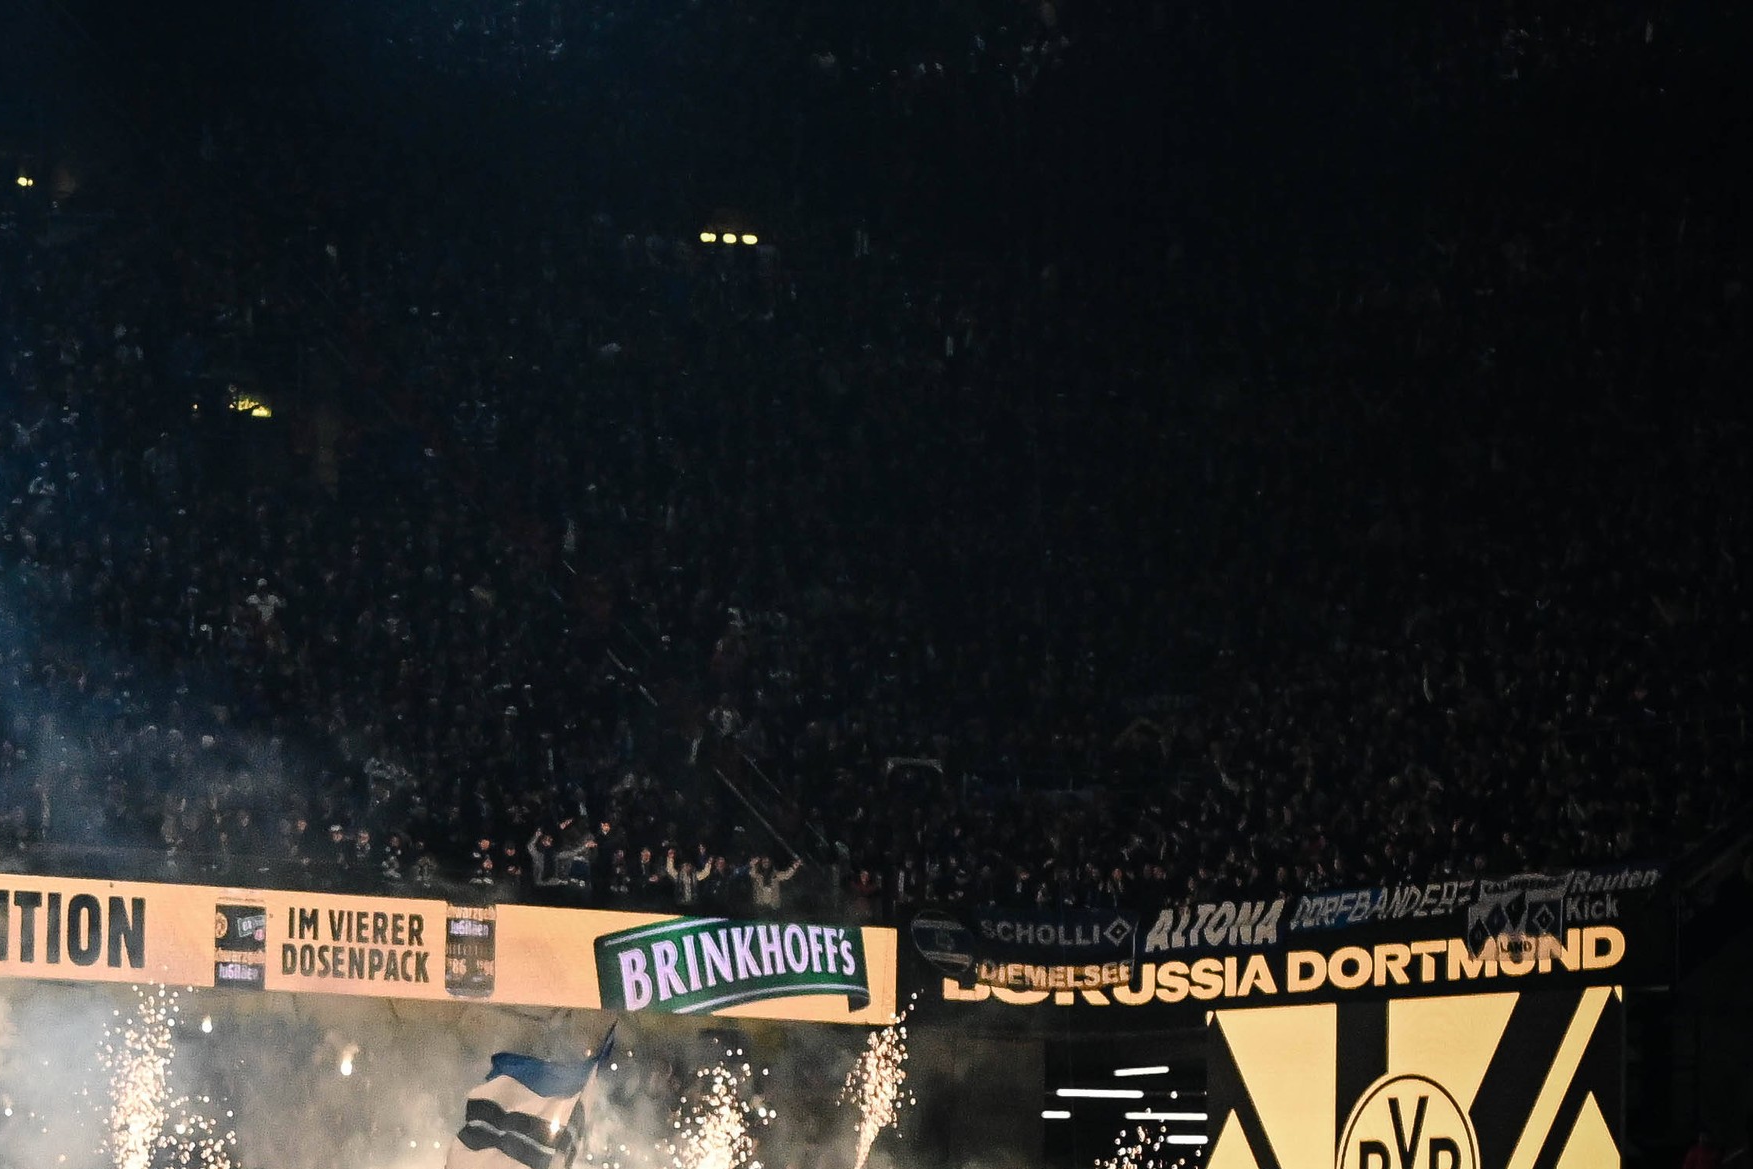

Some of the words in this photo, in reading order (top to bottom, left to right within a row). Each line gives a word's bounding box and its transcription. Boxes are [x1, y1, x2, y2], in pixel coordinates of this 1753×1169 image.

[288, 906, 319, 940] IM
[329, 908, 425, 946] VIERER
[1145, 899, 1286, 953] ALTONA
[1564, 895, 1620, 922] Kick
[980, 917, 1100, 947] SCHOLLI
[282, 942, 430, 983] DOSENPACK
[1286, 925, 1627, 994] DORTMUND
